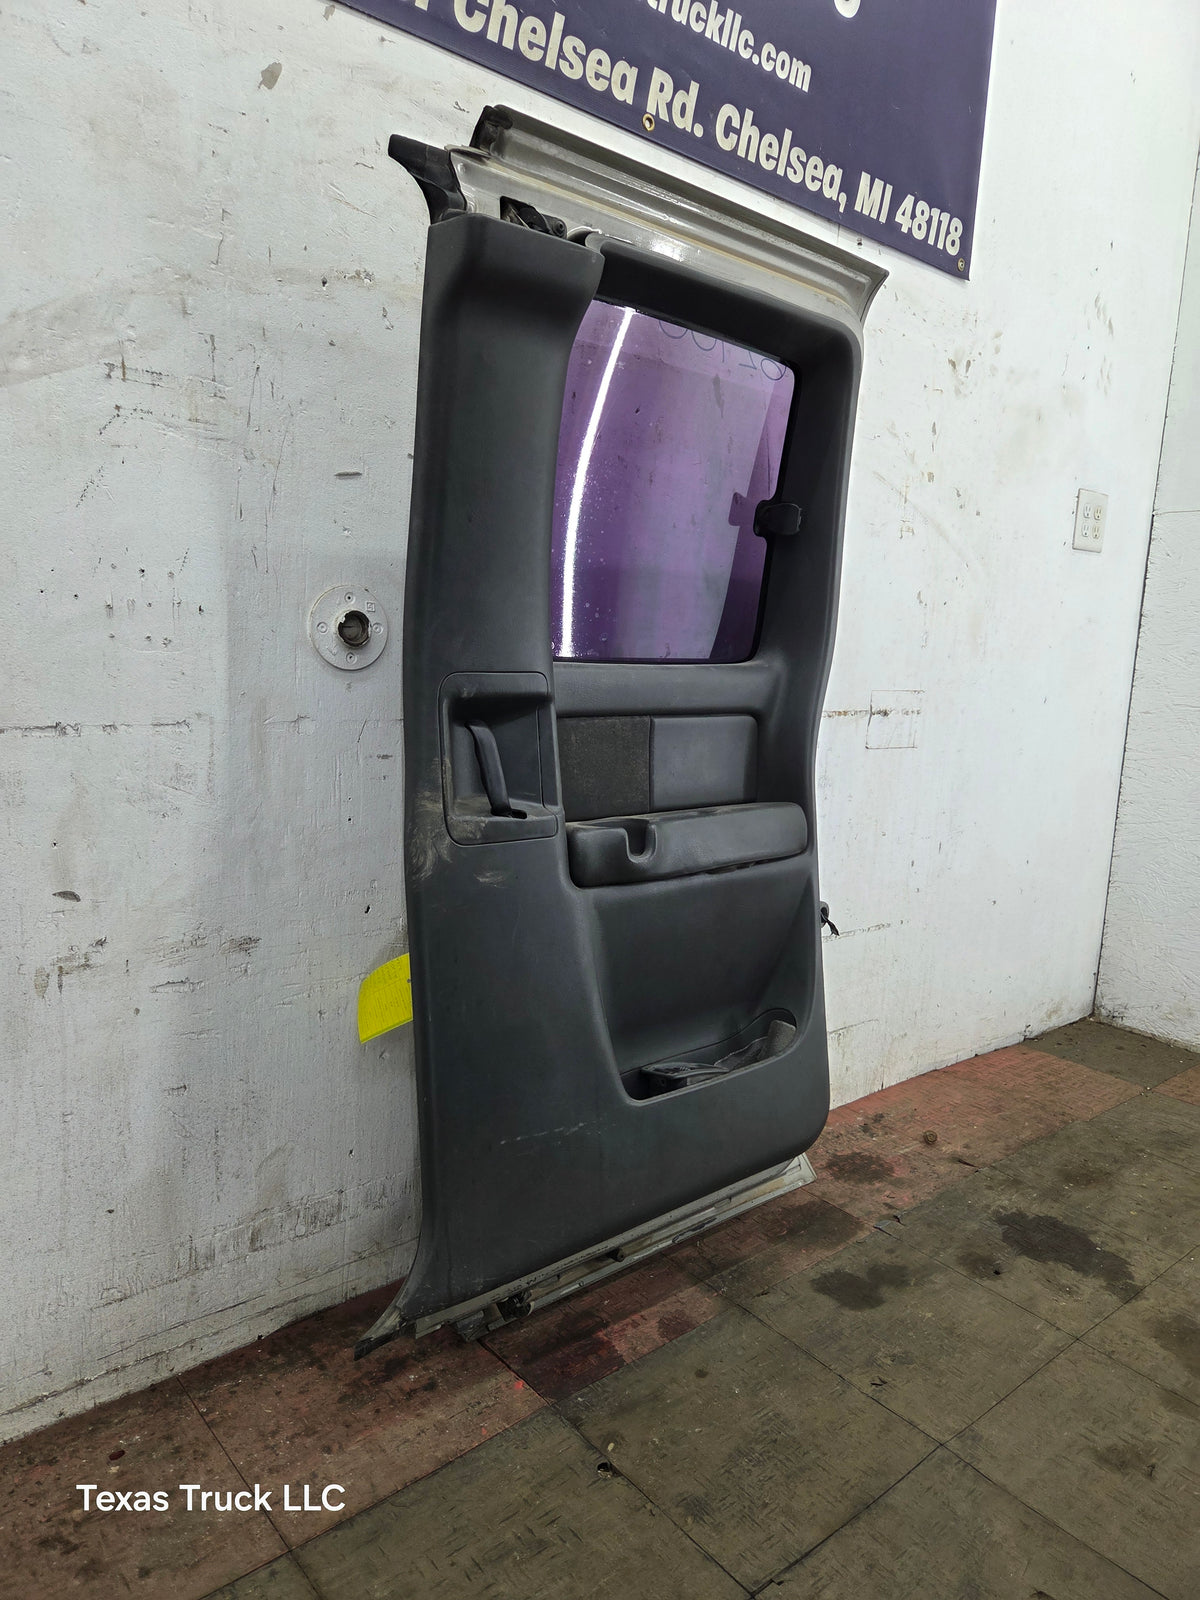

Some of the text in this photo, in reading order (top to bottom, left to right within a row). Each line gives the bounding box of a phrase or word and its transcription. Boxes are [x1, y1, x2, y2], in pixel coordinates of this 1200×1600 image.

[453, 0, 963, 256] Chelsea Rd. Chelsea, MI 48118
